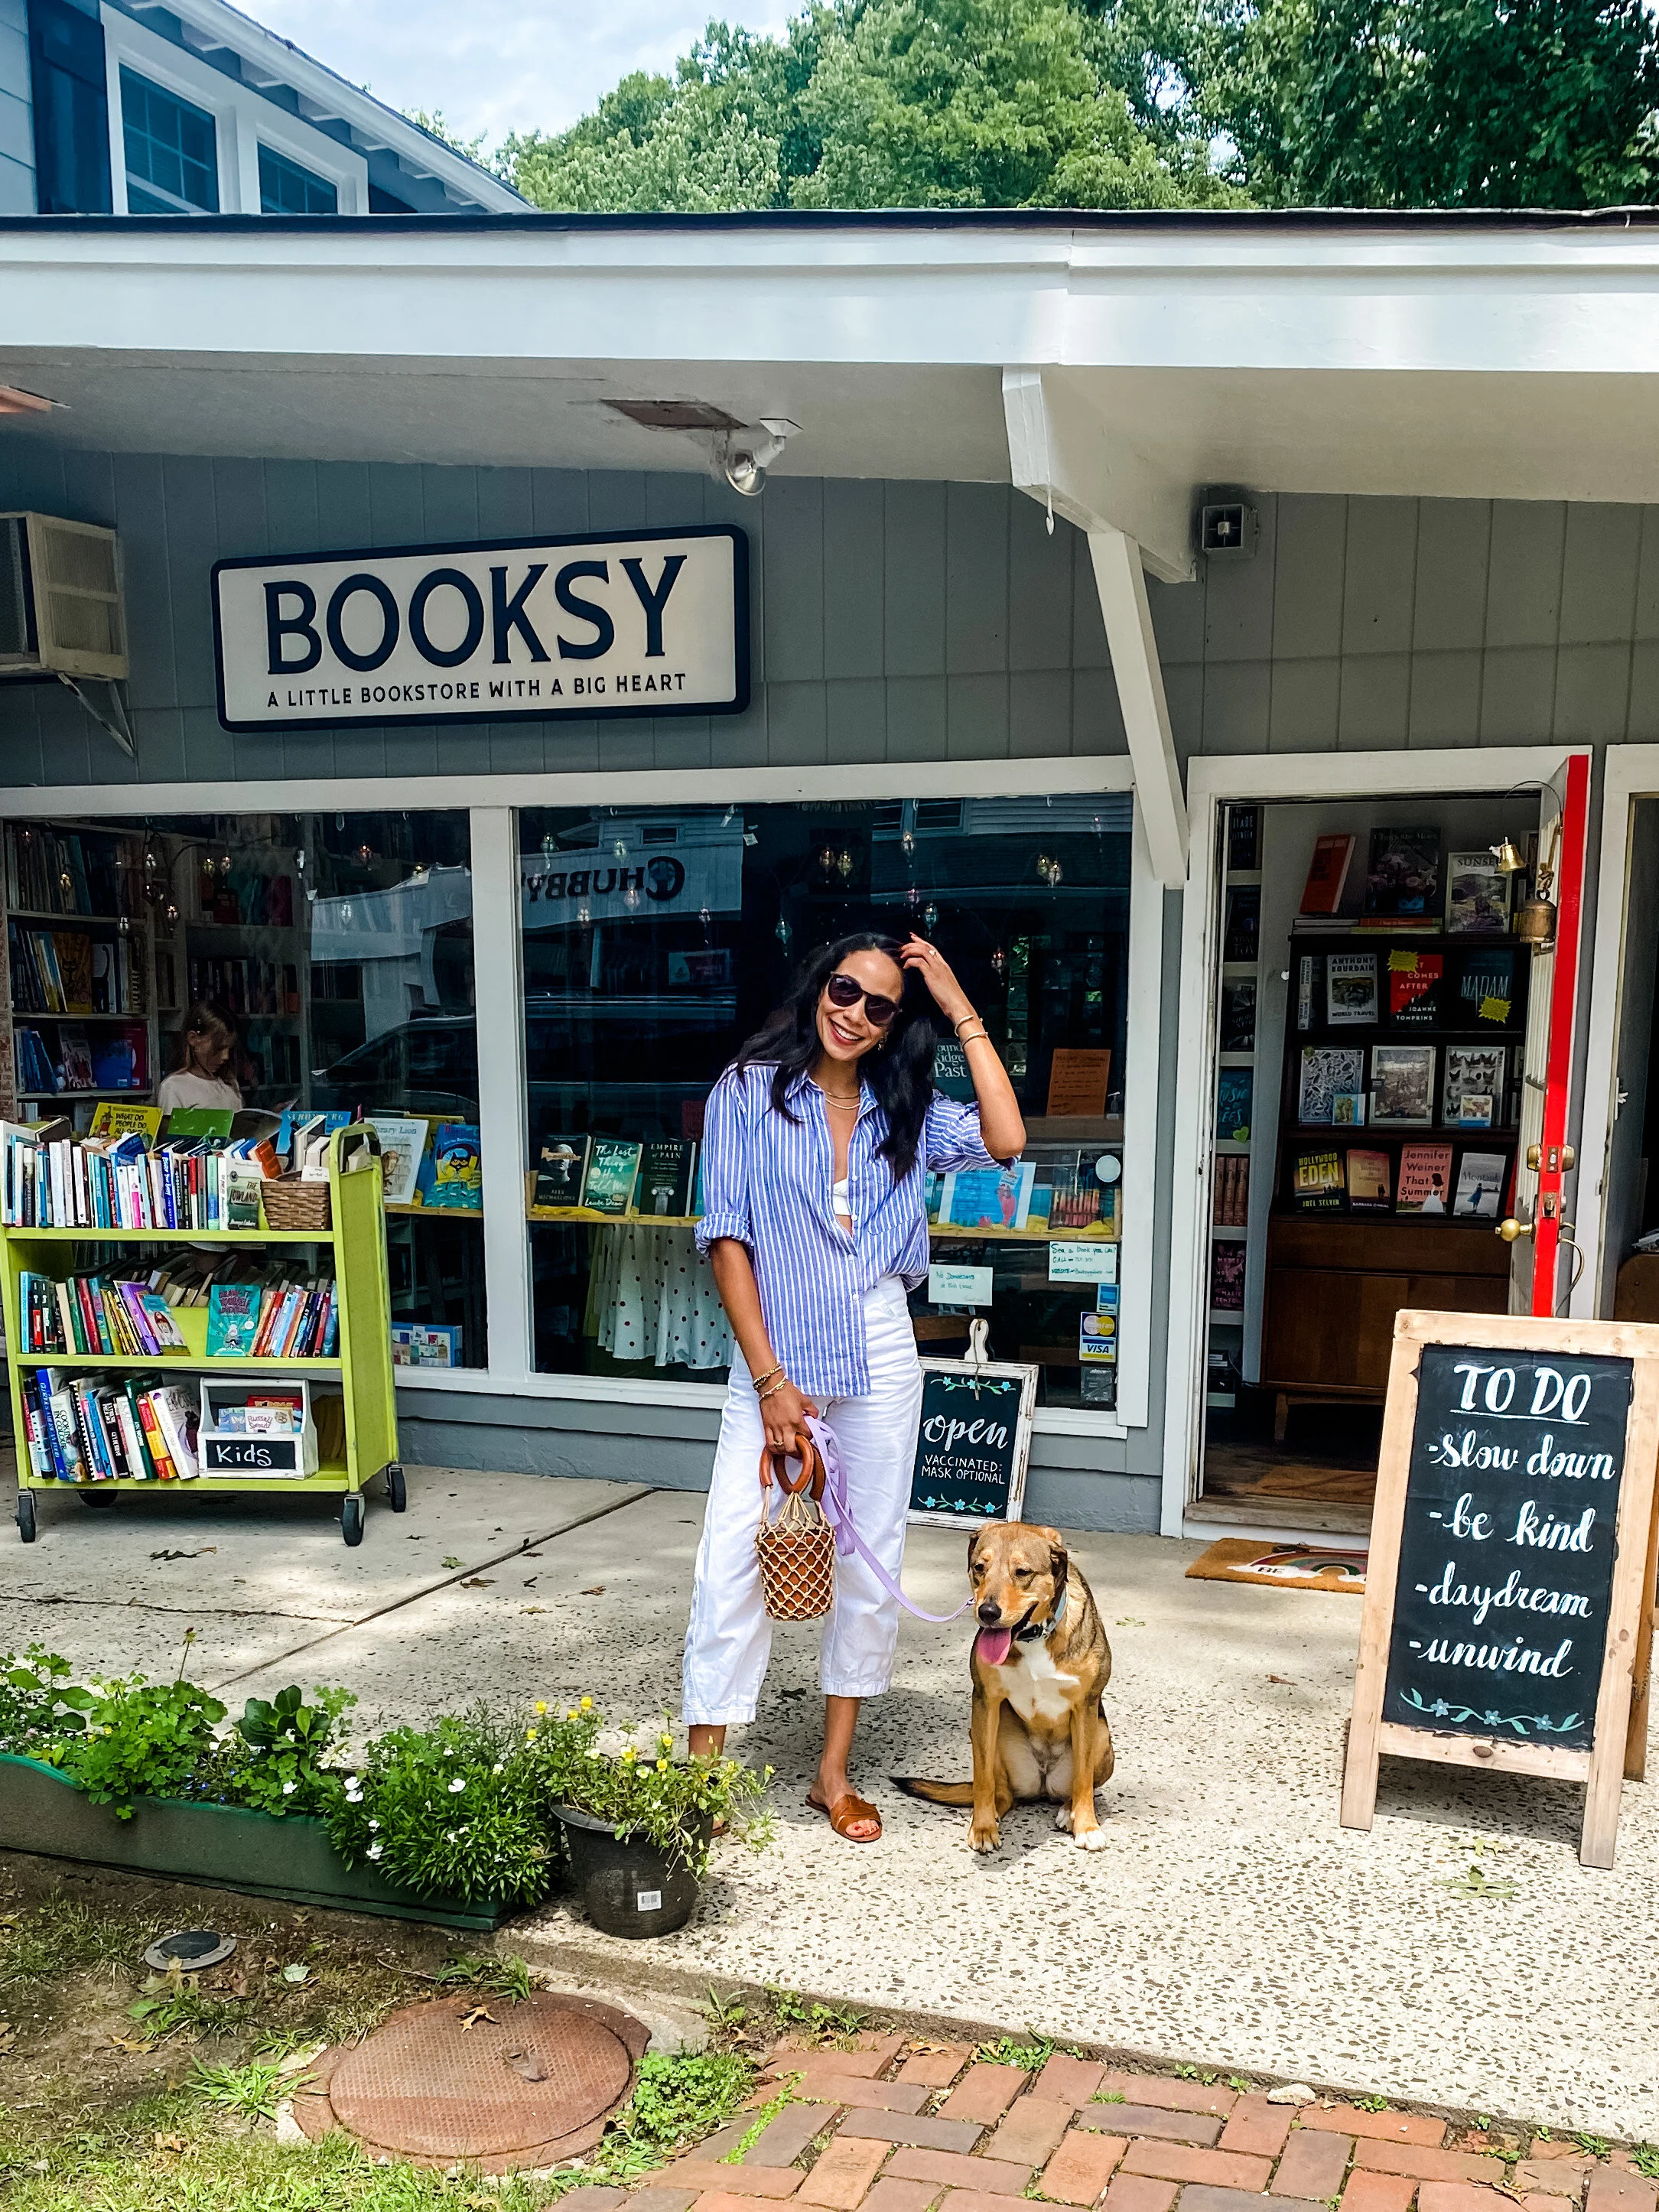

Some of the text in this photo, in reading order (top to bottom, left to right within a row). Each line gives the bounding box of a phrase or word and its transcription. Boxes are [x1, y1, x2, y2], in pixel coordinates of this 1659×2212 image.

[262, 555, 688, 675] BOOKSY
[266, 672, 687, 708] A LITTLE BOOKSTORE WITH A BIG HEART
[1458, 857, 1495, 866] SUNSE
[1460, 975, 1508, 1005] MADAM
[937, 1041, 962, 1052] ound
[934, 1062, 968, 1078] Past
[595, 1144, 636, 1156] The Last
[1404, 1150, 1450, 1160] Jennifer
[598, 1156, 627, 1173] Thing
[1298, 1152, 1337, 1166] HOLLYWOOD
[1299, 1162, 1339, 1186] EDEN
[1406, 1163, 1446, 1172] Weiner
[246, 1181, 258, 1190] THE
[1406, 1175, 1430, 1185] That
[1400, 1186, 1444, 1196] Summer
[1087, 1344, 1109, 1353] VISA
[1453, 1364, 1592, 1420] TO DO
[60, 1410, 71, 1445] COOKING
[216, 1443, 272, 1467] Kids
[924, 1454, 1003, 1472] VACCINATED:
[1527, 1434, 1616, 1481] down
[921, 1465, 1006, 1485] MASK OPTIONAL
[1506, 1499, 1596, 1553] kind
[1257, 1566, 1286, 1575] BE
